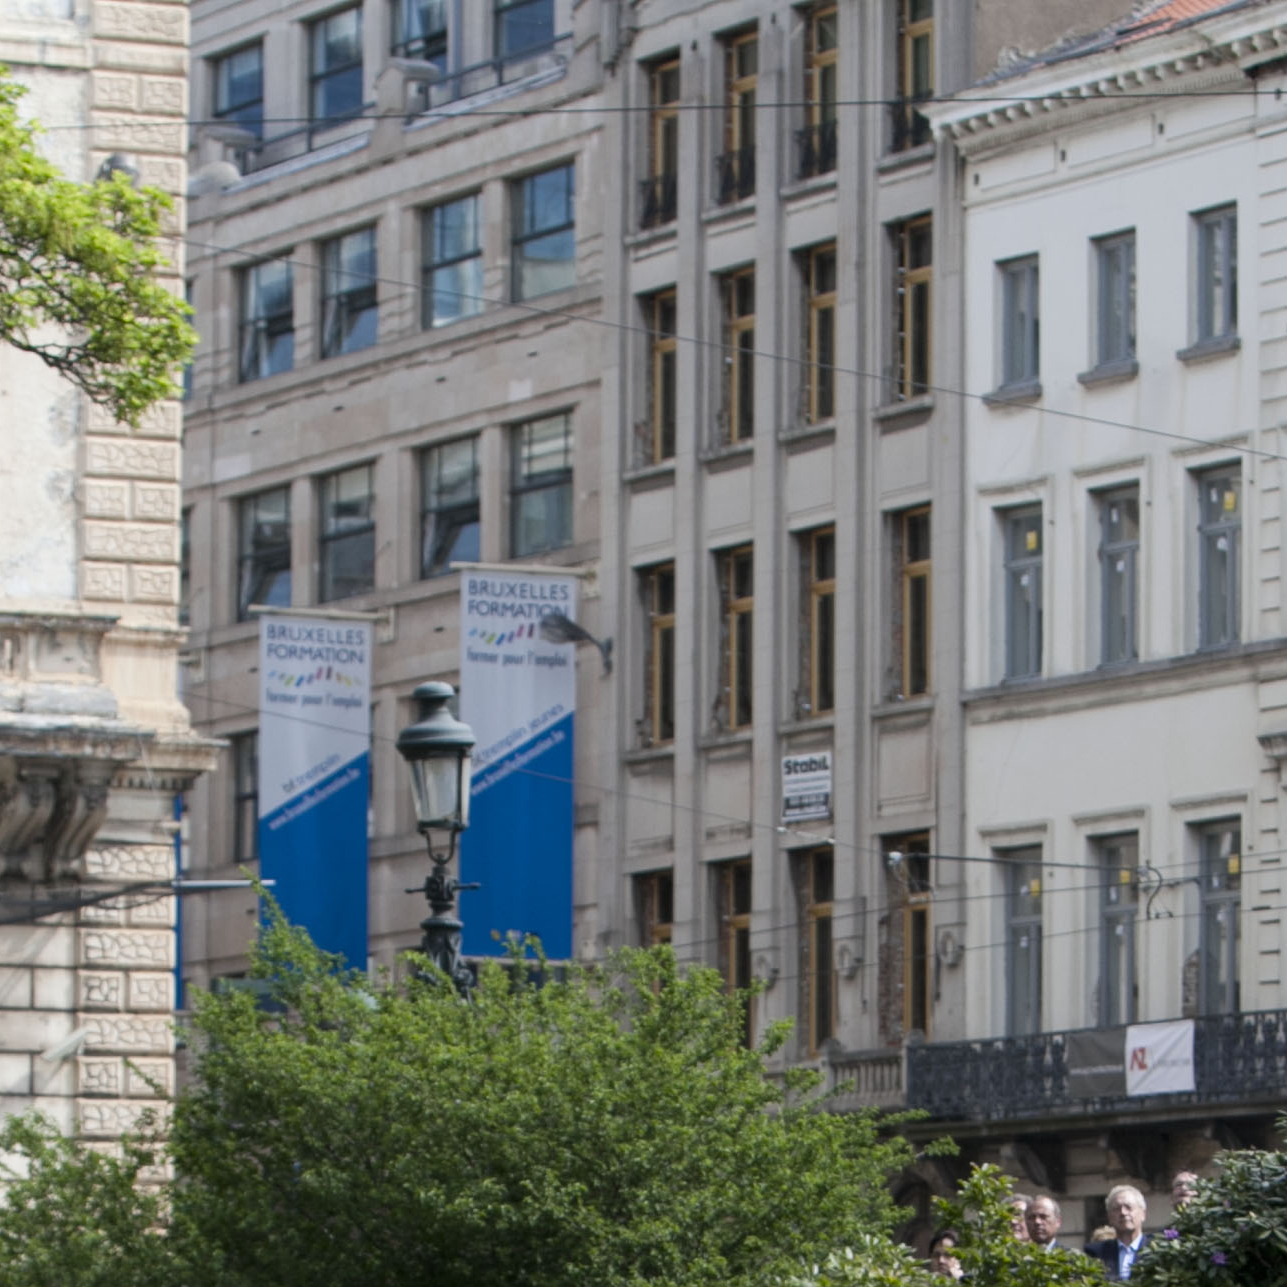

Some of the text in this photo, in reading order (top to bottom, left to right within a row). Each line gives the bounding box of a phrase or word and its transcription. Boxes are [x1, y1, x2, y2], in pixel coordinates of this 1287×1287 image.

[468, 578, 570, 601] BRUXELLES
[468, 599, 569, 619] FORMATION
[266, 623, 364, 645] BRUXELLES
[266, 643, 364, 664] FORMATION
